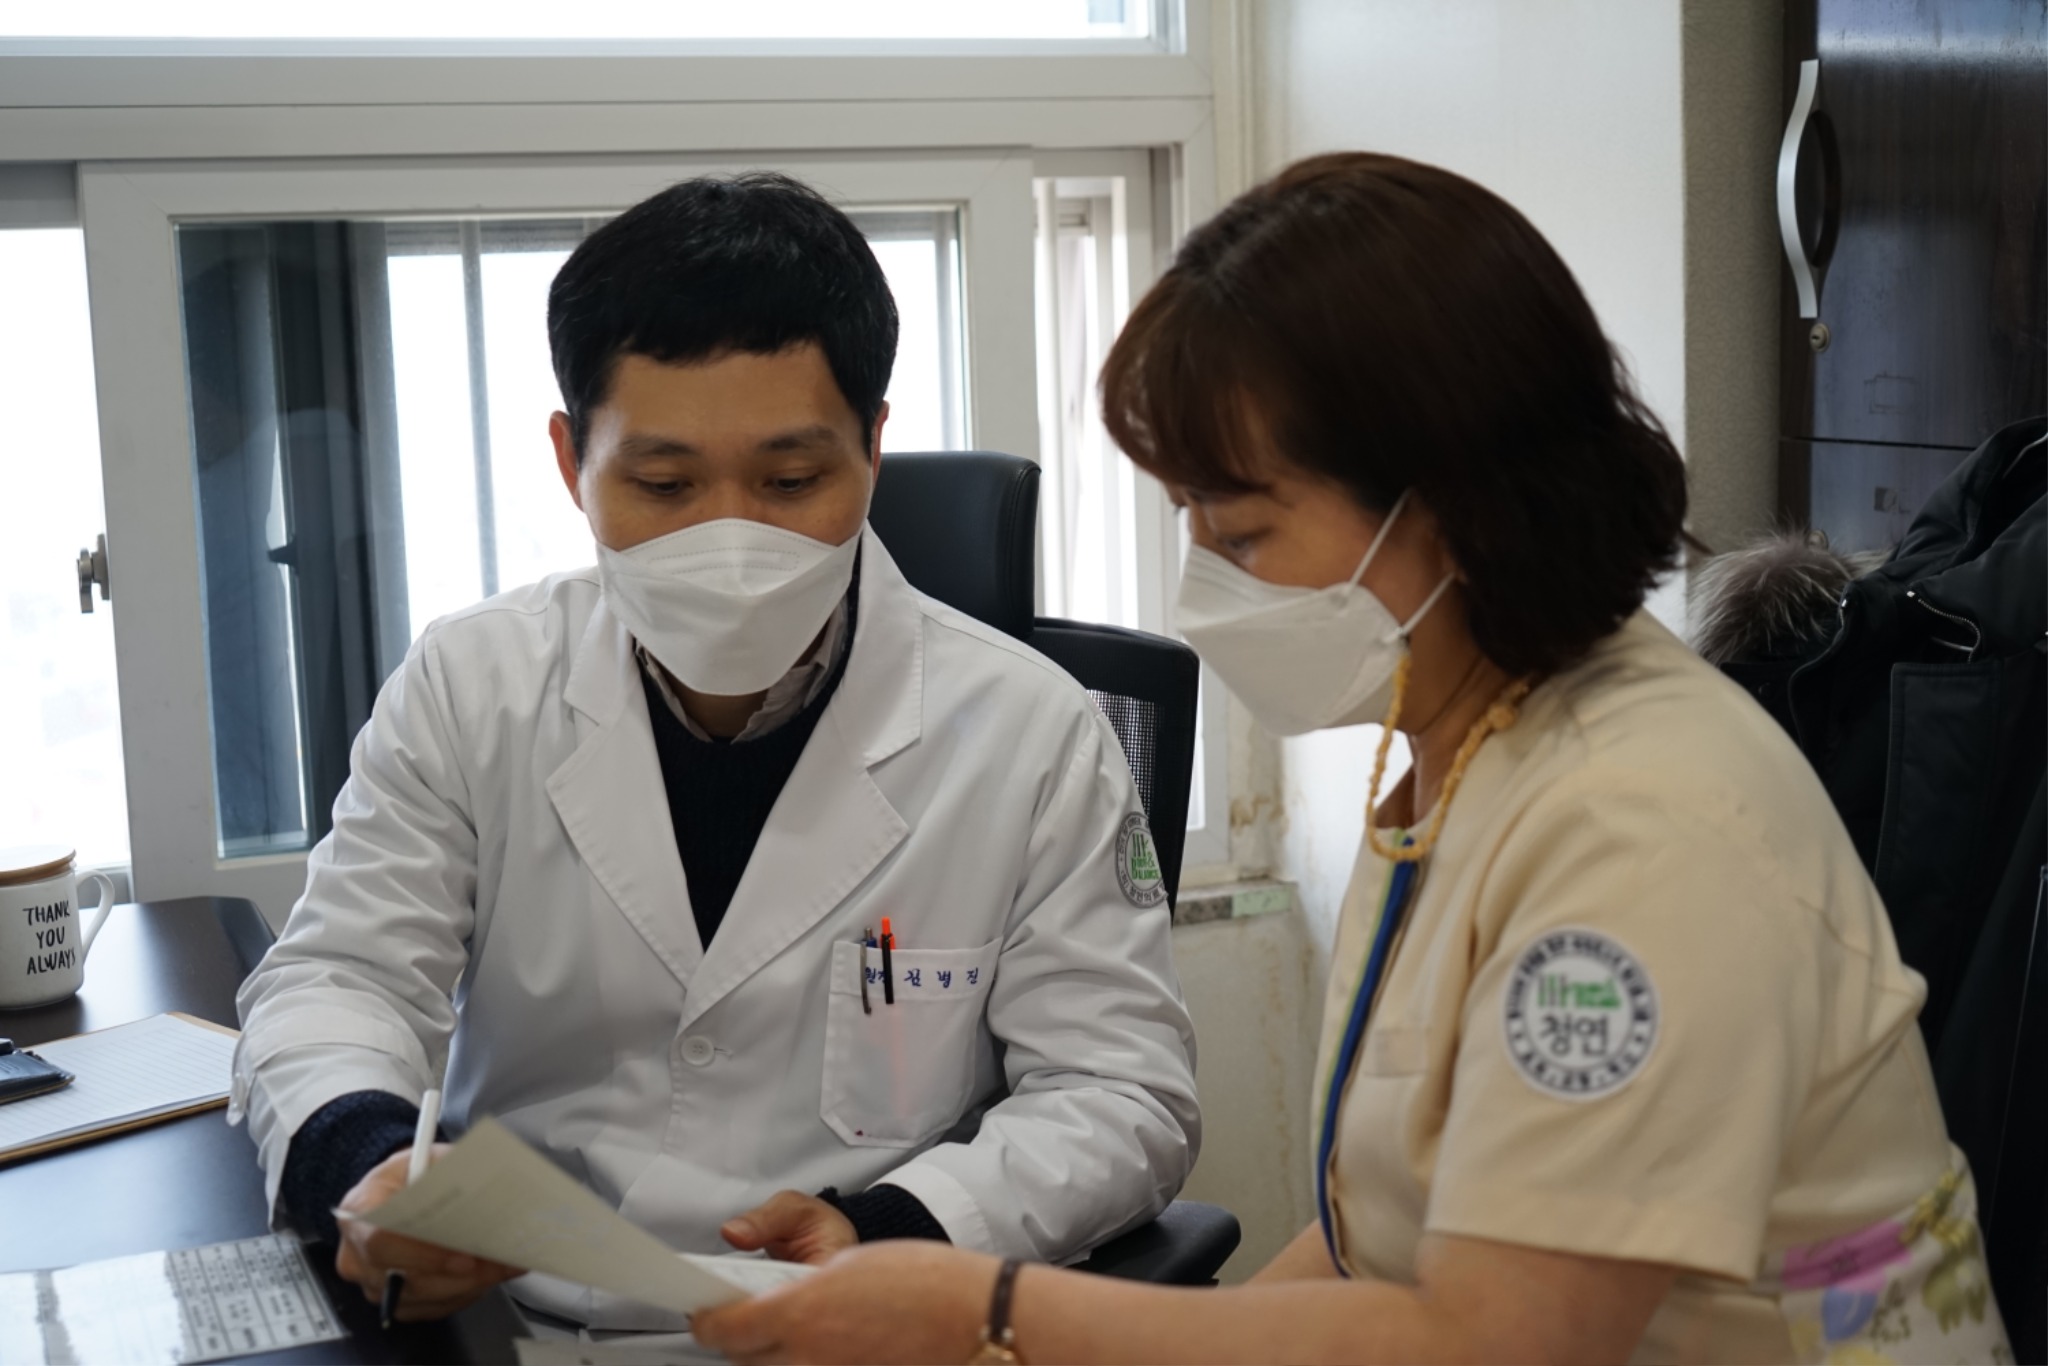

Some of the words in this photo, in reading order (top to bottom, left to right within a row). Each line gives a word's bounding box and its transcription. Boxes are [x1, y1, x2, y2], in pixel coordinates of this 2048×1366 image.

[22, 900, 70, 926] THANK
[36, 926, 65, 949] YOU
[26, 947, 76, 975] ALWAYS
